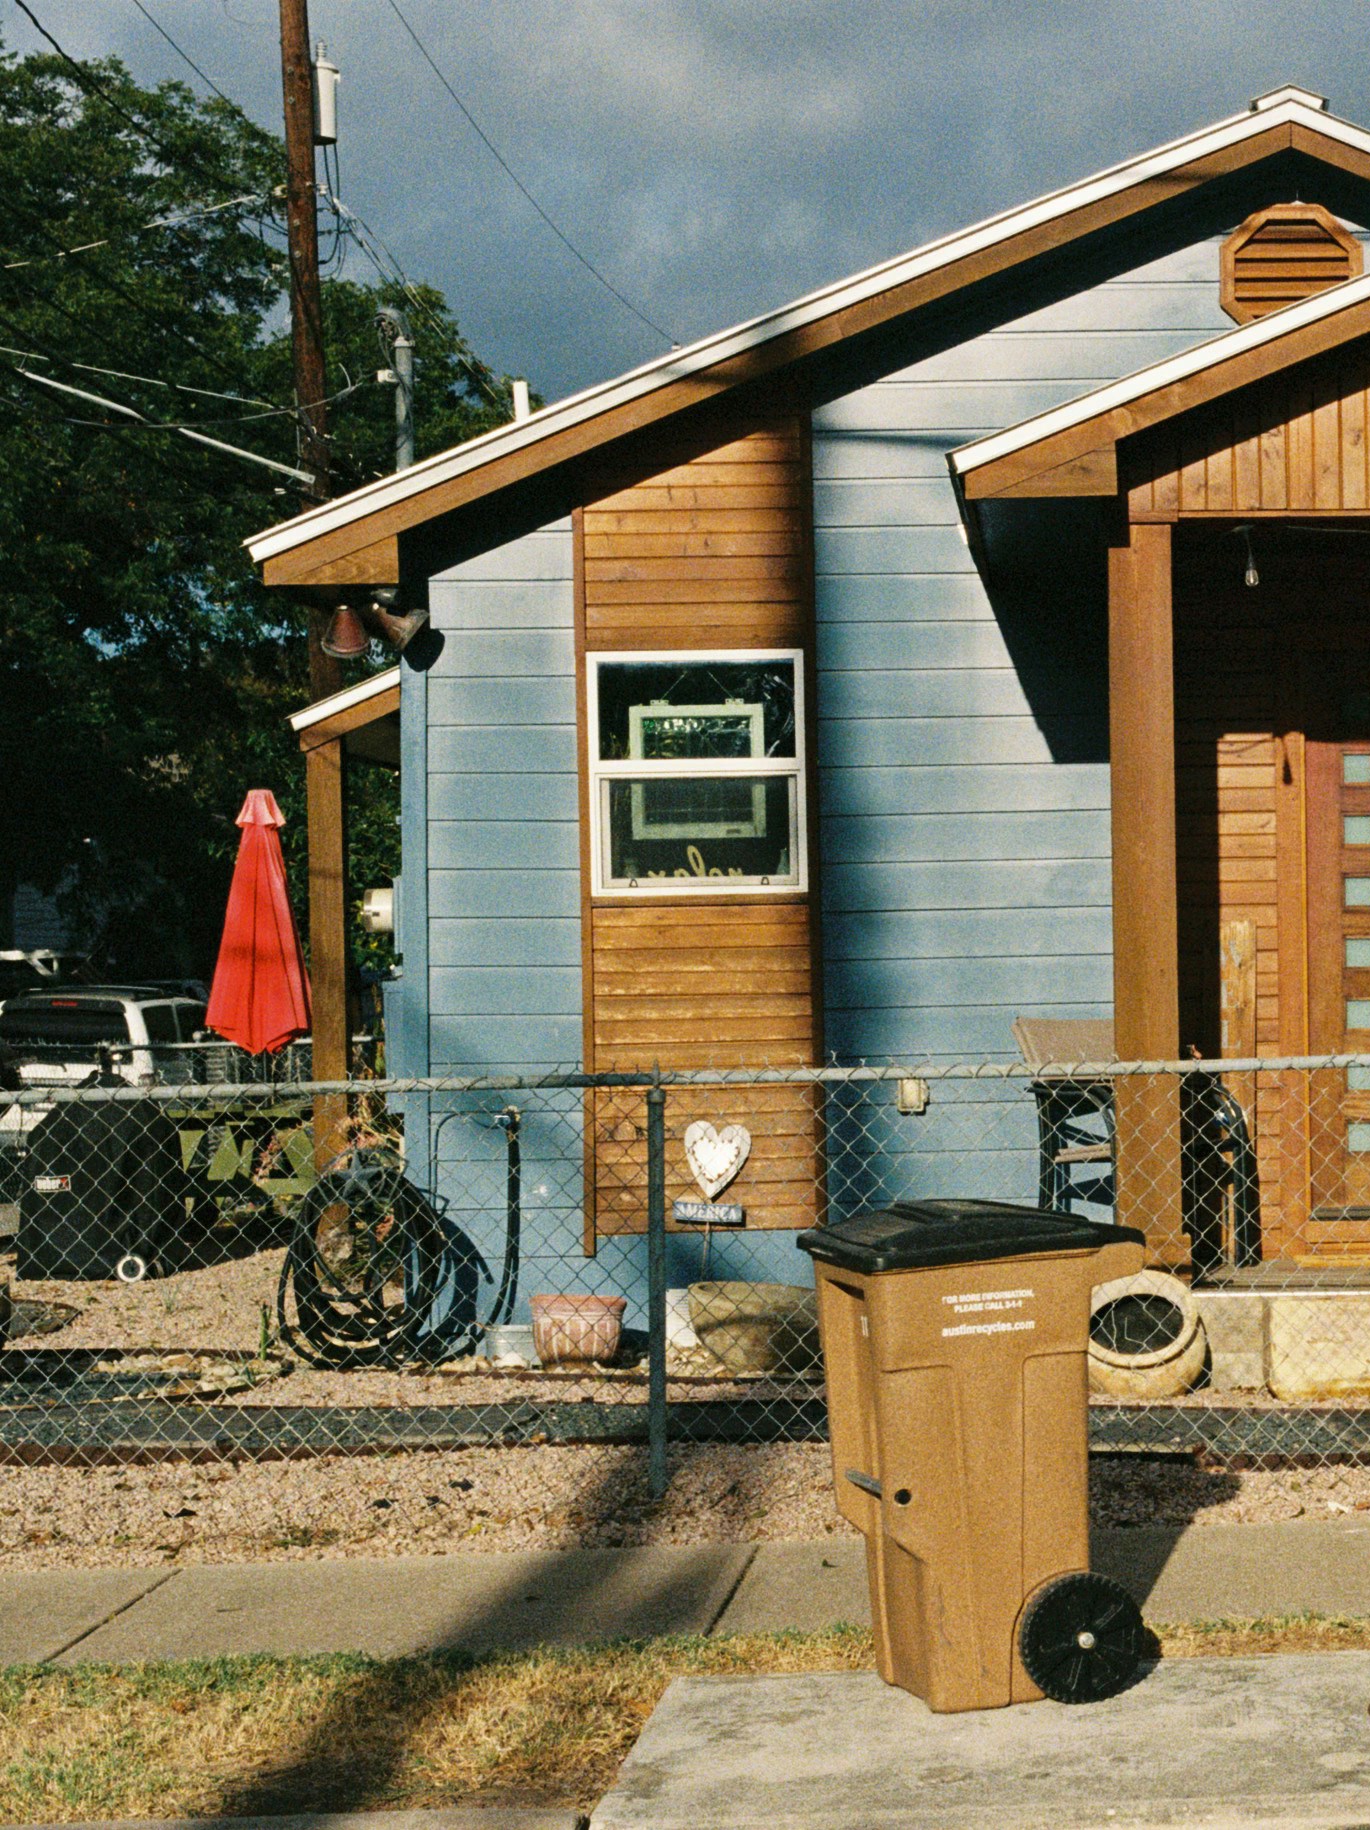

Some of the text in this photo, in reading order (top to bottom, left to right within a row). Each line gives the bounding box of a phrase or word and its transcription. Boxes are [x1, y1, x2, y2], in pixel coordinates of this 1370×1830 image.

[942, 1296, 958, 1305] FOR
[959, 1293, 981, 1303] MORE
[954, 1303, 983, 1313] PLEASE
[985, 1301, 1004, 1310] CALL
[942, 1321, 1035, 1336] austinrecycles.com
